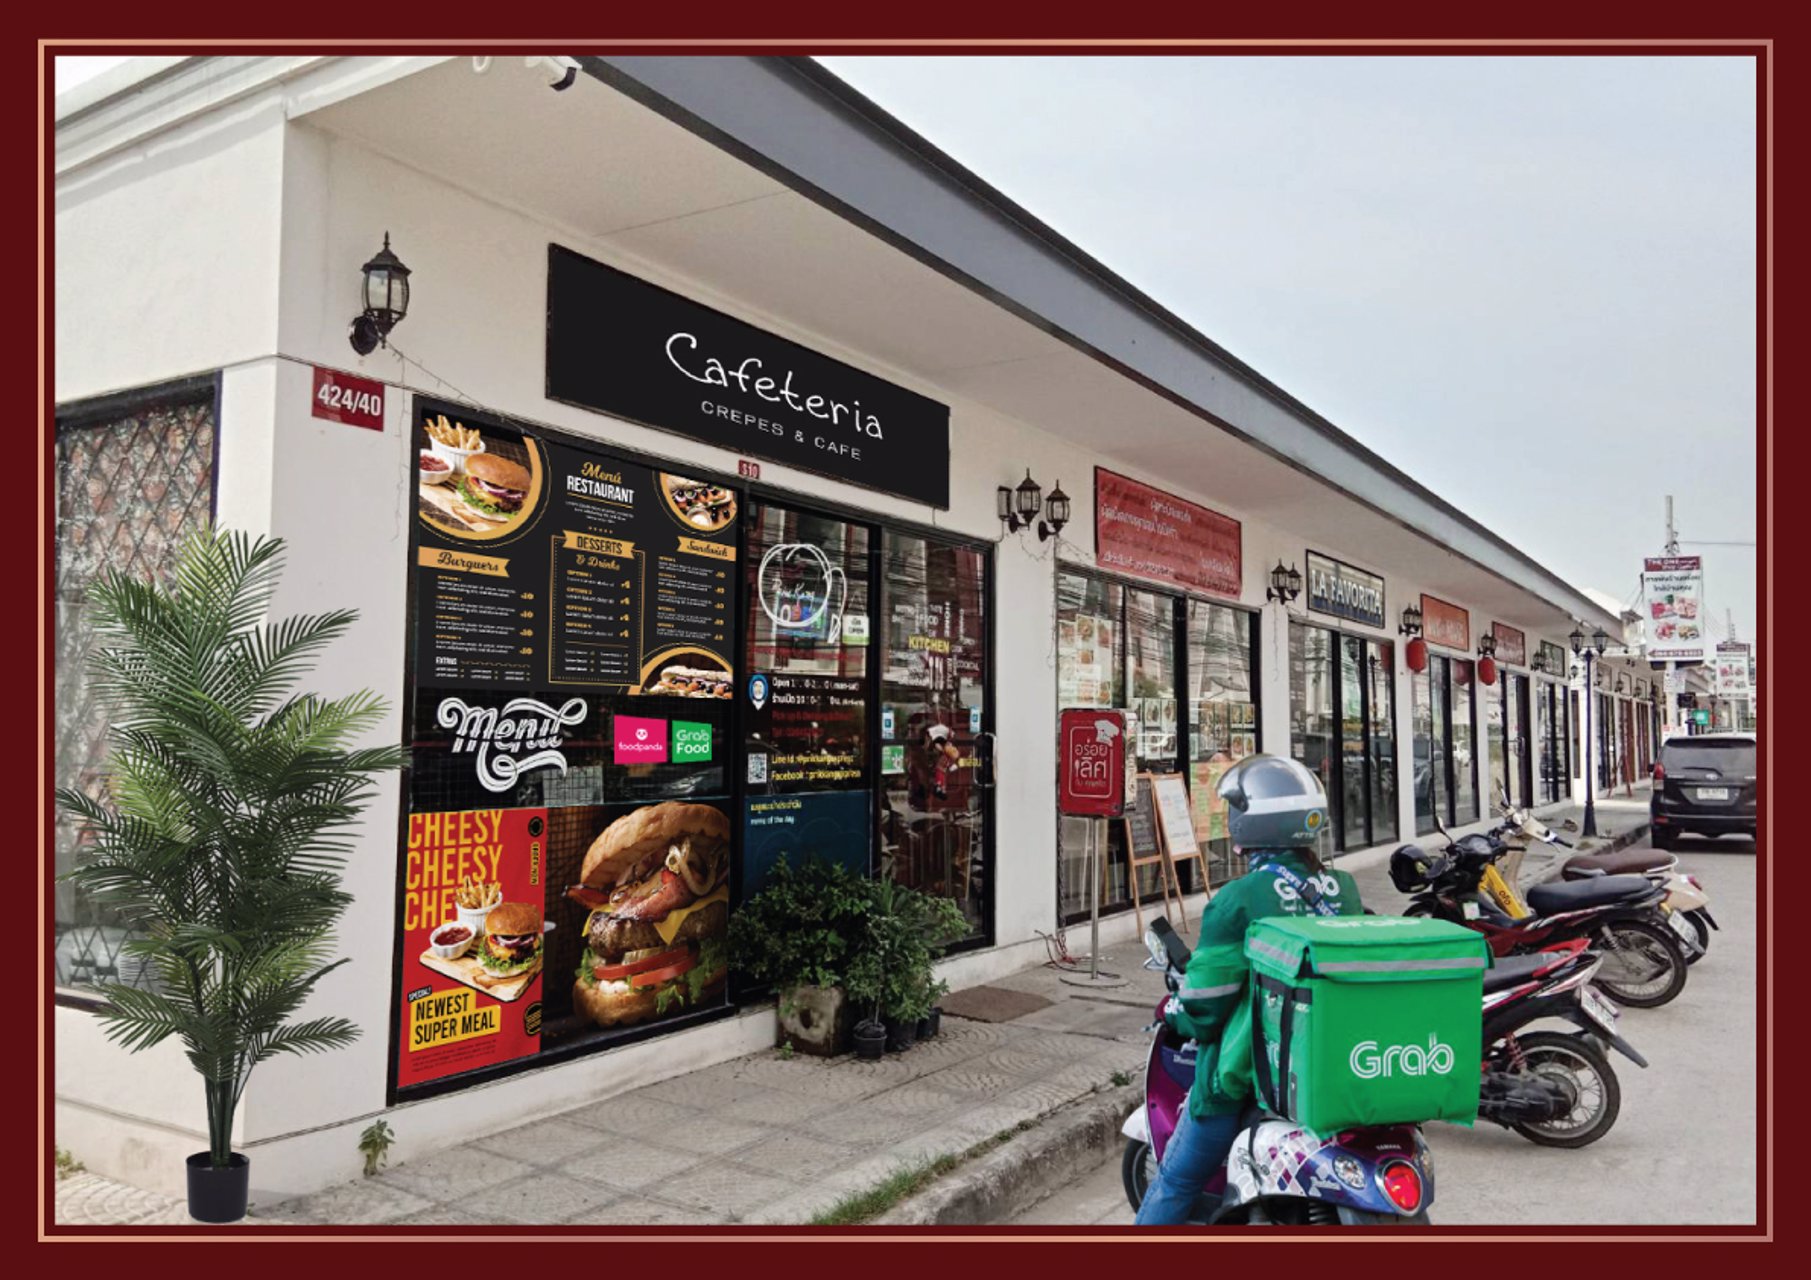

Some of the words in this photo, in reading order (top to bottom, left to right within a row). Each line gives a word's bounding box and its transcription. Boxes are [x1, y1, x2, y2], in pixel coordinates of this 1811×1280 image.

[317, 383, 382, 417] 424/40
[665, 332, 884, 440] Cafeteria
[701, 400, 784, 436] CREPES
[794, 429, 805, 443] &
[814, 436, 862, 461] CAFE
[566, 475, 635, 504] RESTAURANT
[577, 536, 622, 555] DESSERTS
[437, 551, 499, 572] Burguers
[1311, 569, 1328, 598] LA
[1330, 575, 1381, 615] FAVORITA
[908, 635, 950, 654] KITCHEN
[618, 741, 663, 752] foodpanda
[676, 729, 710, 742] Grab
[676, 742, 710, 754] Food
[1074, 738, 1108, 757] อร่อย
[407, 809, 504, 849] CHEESY
[406, 844, 504, 890] CHEESY
[416, 993, 469, 1021] NEWEST
[415, 1018, 457, 1045] SUPER
[461, 1010, 495, 1035] MEAL
[1349, 1032, 1455, 1079] Grab
